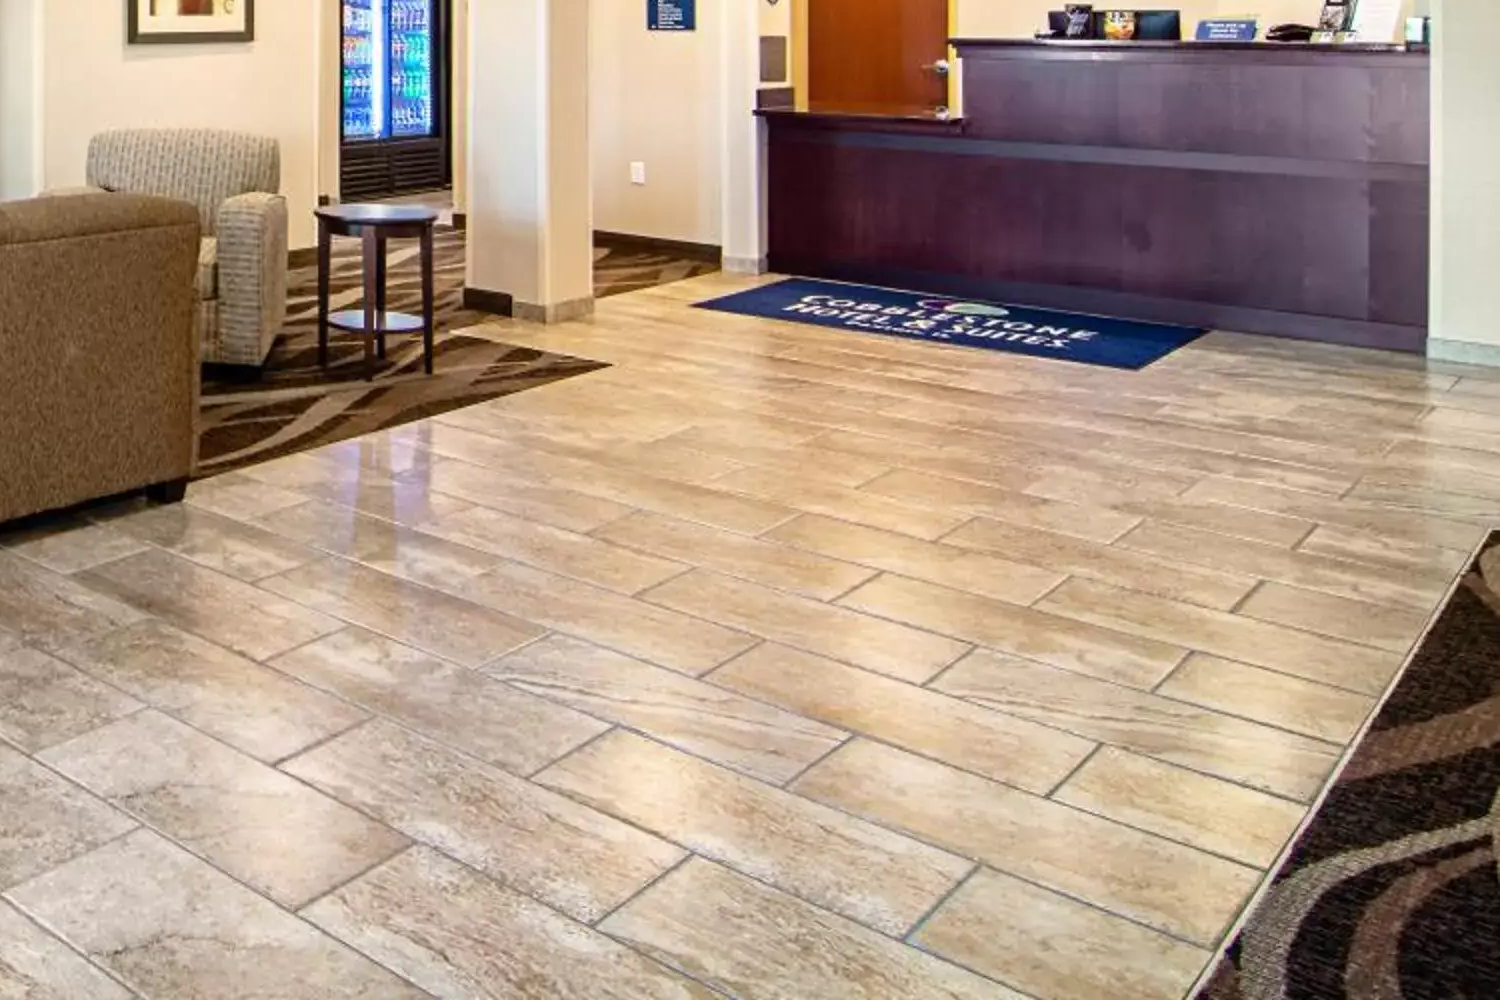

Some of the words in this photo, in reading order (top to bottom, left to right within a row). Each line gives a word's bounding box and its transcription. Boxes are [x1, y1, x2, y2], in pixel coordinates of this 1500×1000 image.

[781, 303, 891, 325] HOTEL
[952, 322, 1070, 348] SUITES
[800, 295, 1099, 341] COBBLESTONE
